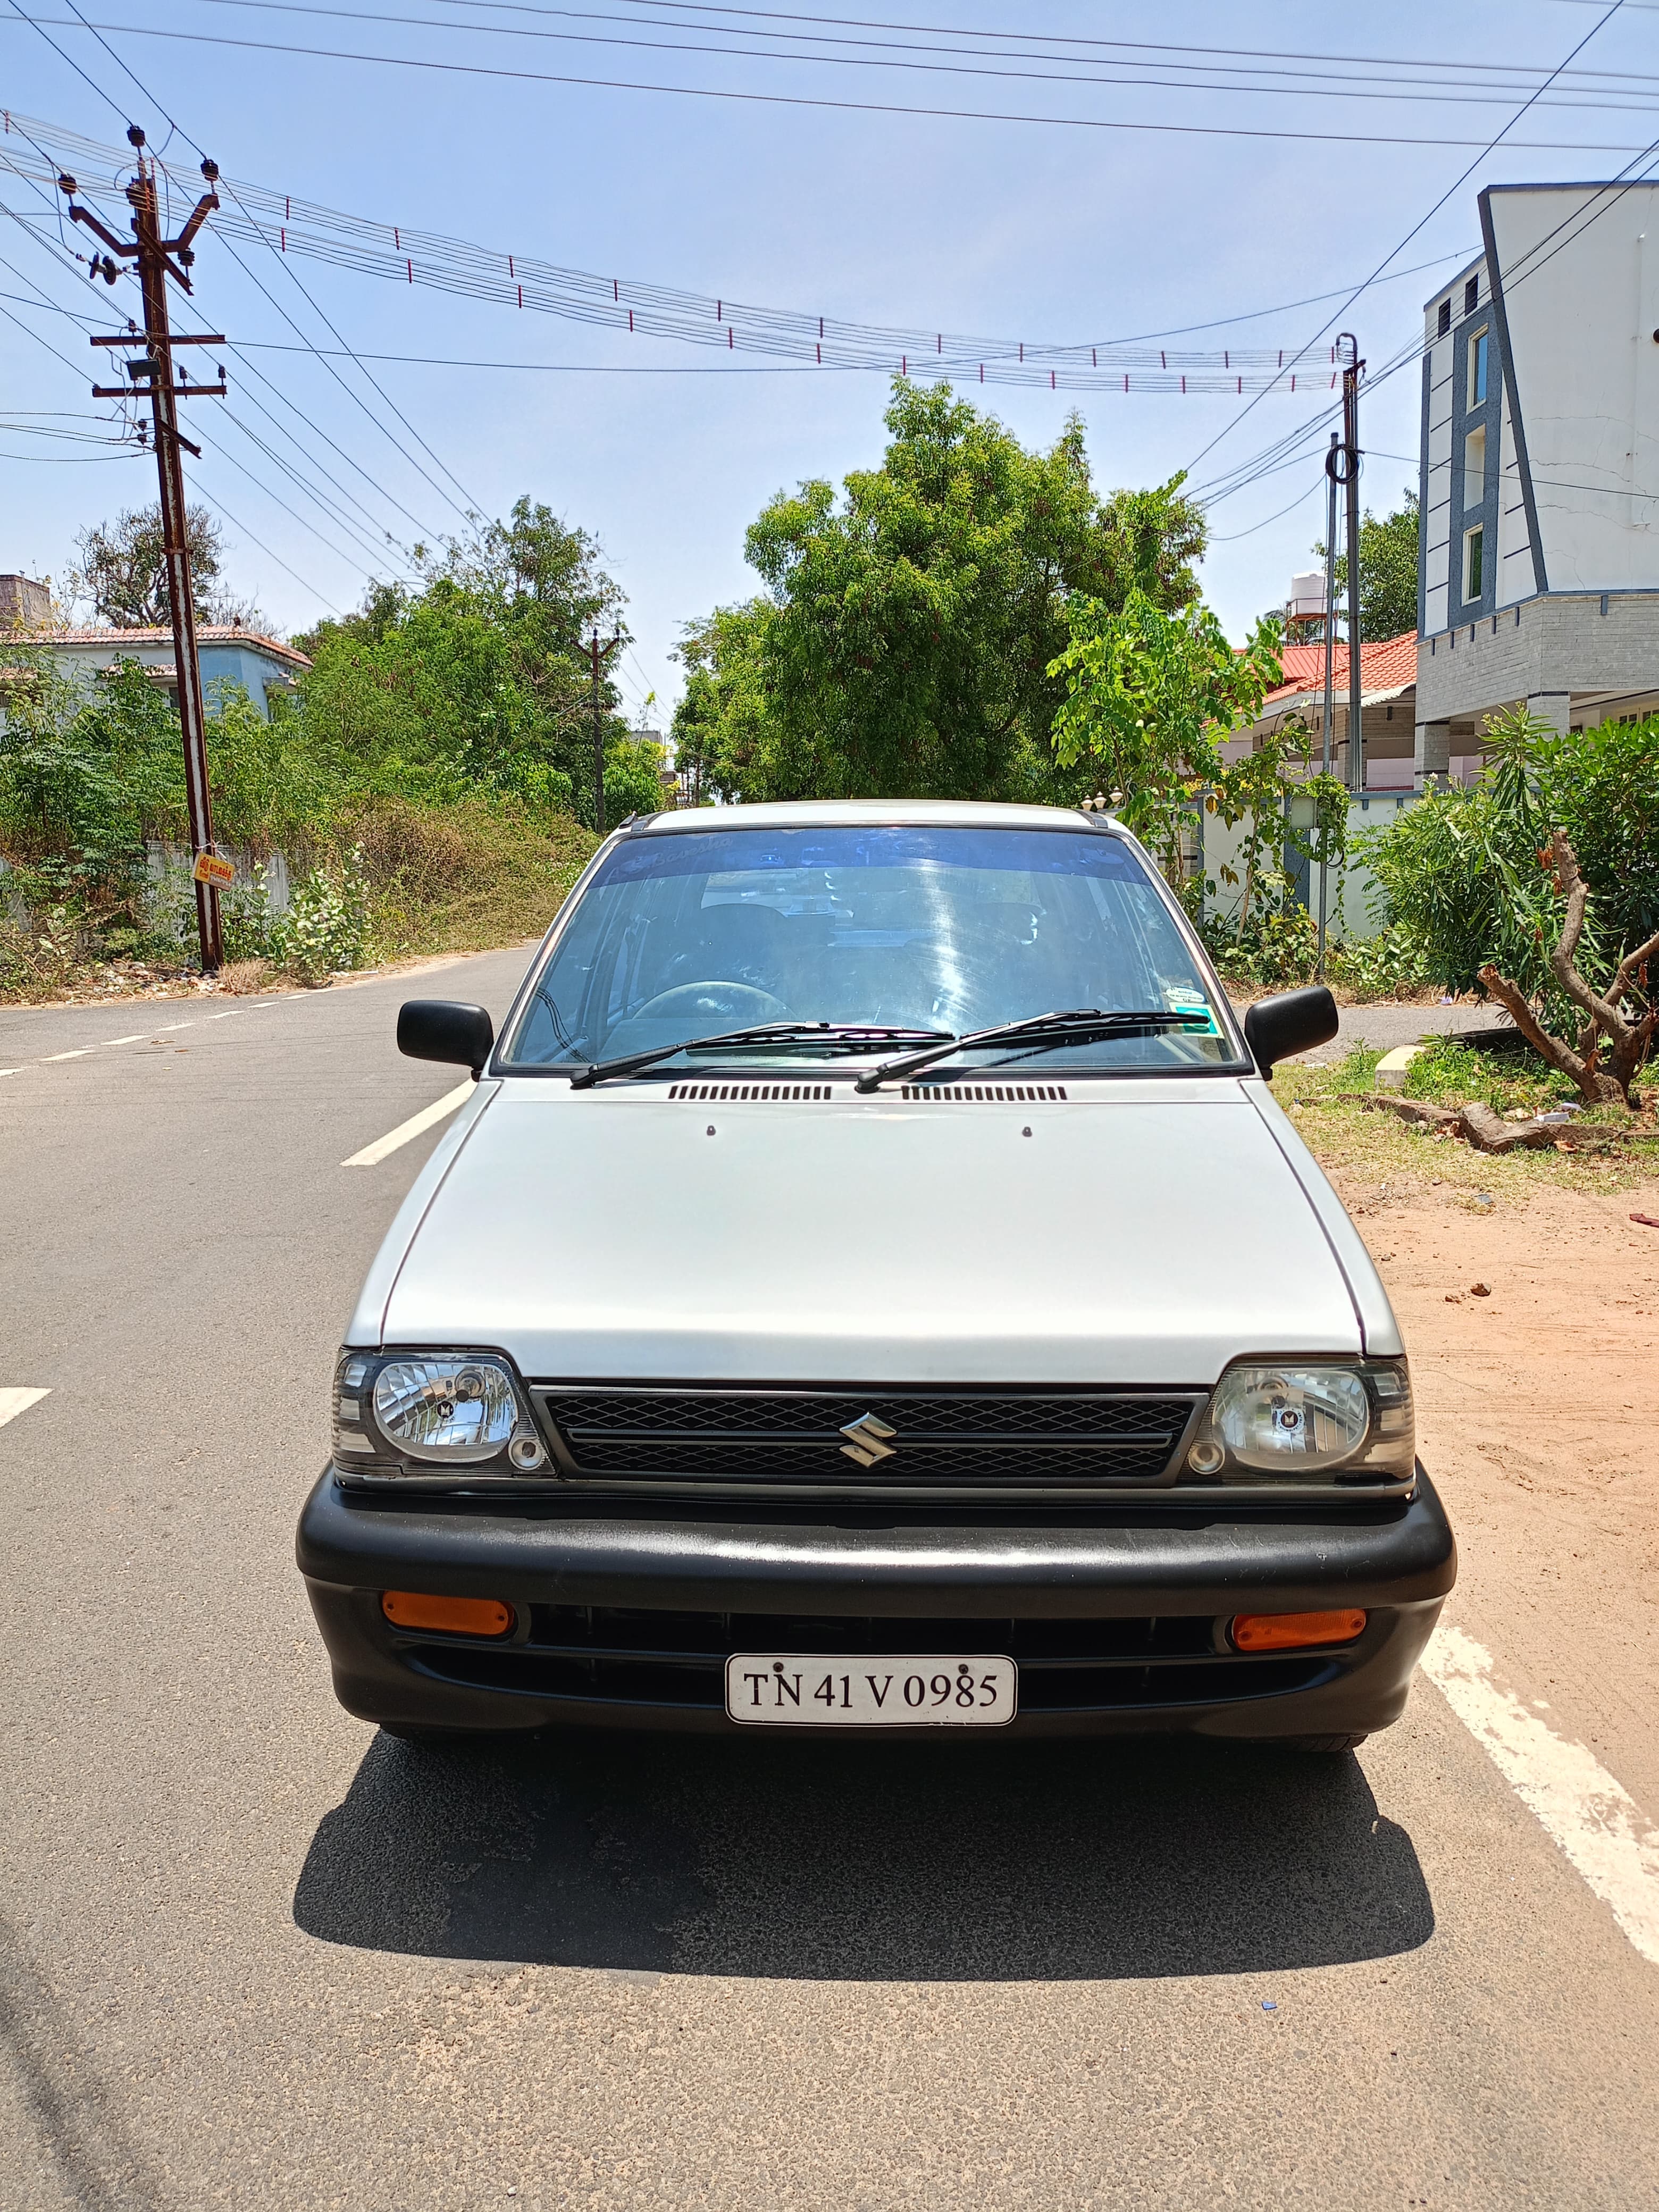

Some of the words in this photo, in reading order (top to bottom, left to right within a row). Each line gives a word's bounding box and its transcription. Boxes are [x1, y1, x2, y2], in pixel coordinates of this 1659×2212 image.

[744, 1673, 803, 1706] TN
[814, 1674, 853, 1708] 41
[865, 1675, 894, 1708] V
[903, 1674, 998, 1708] 0985
